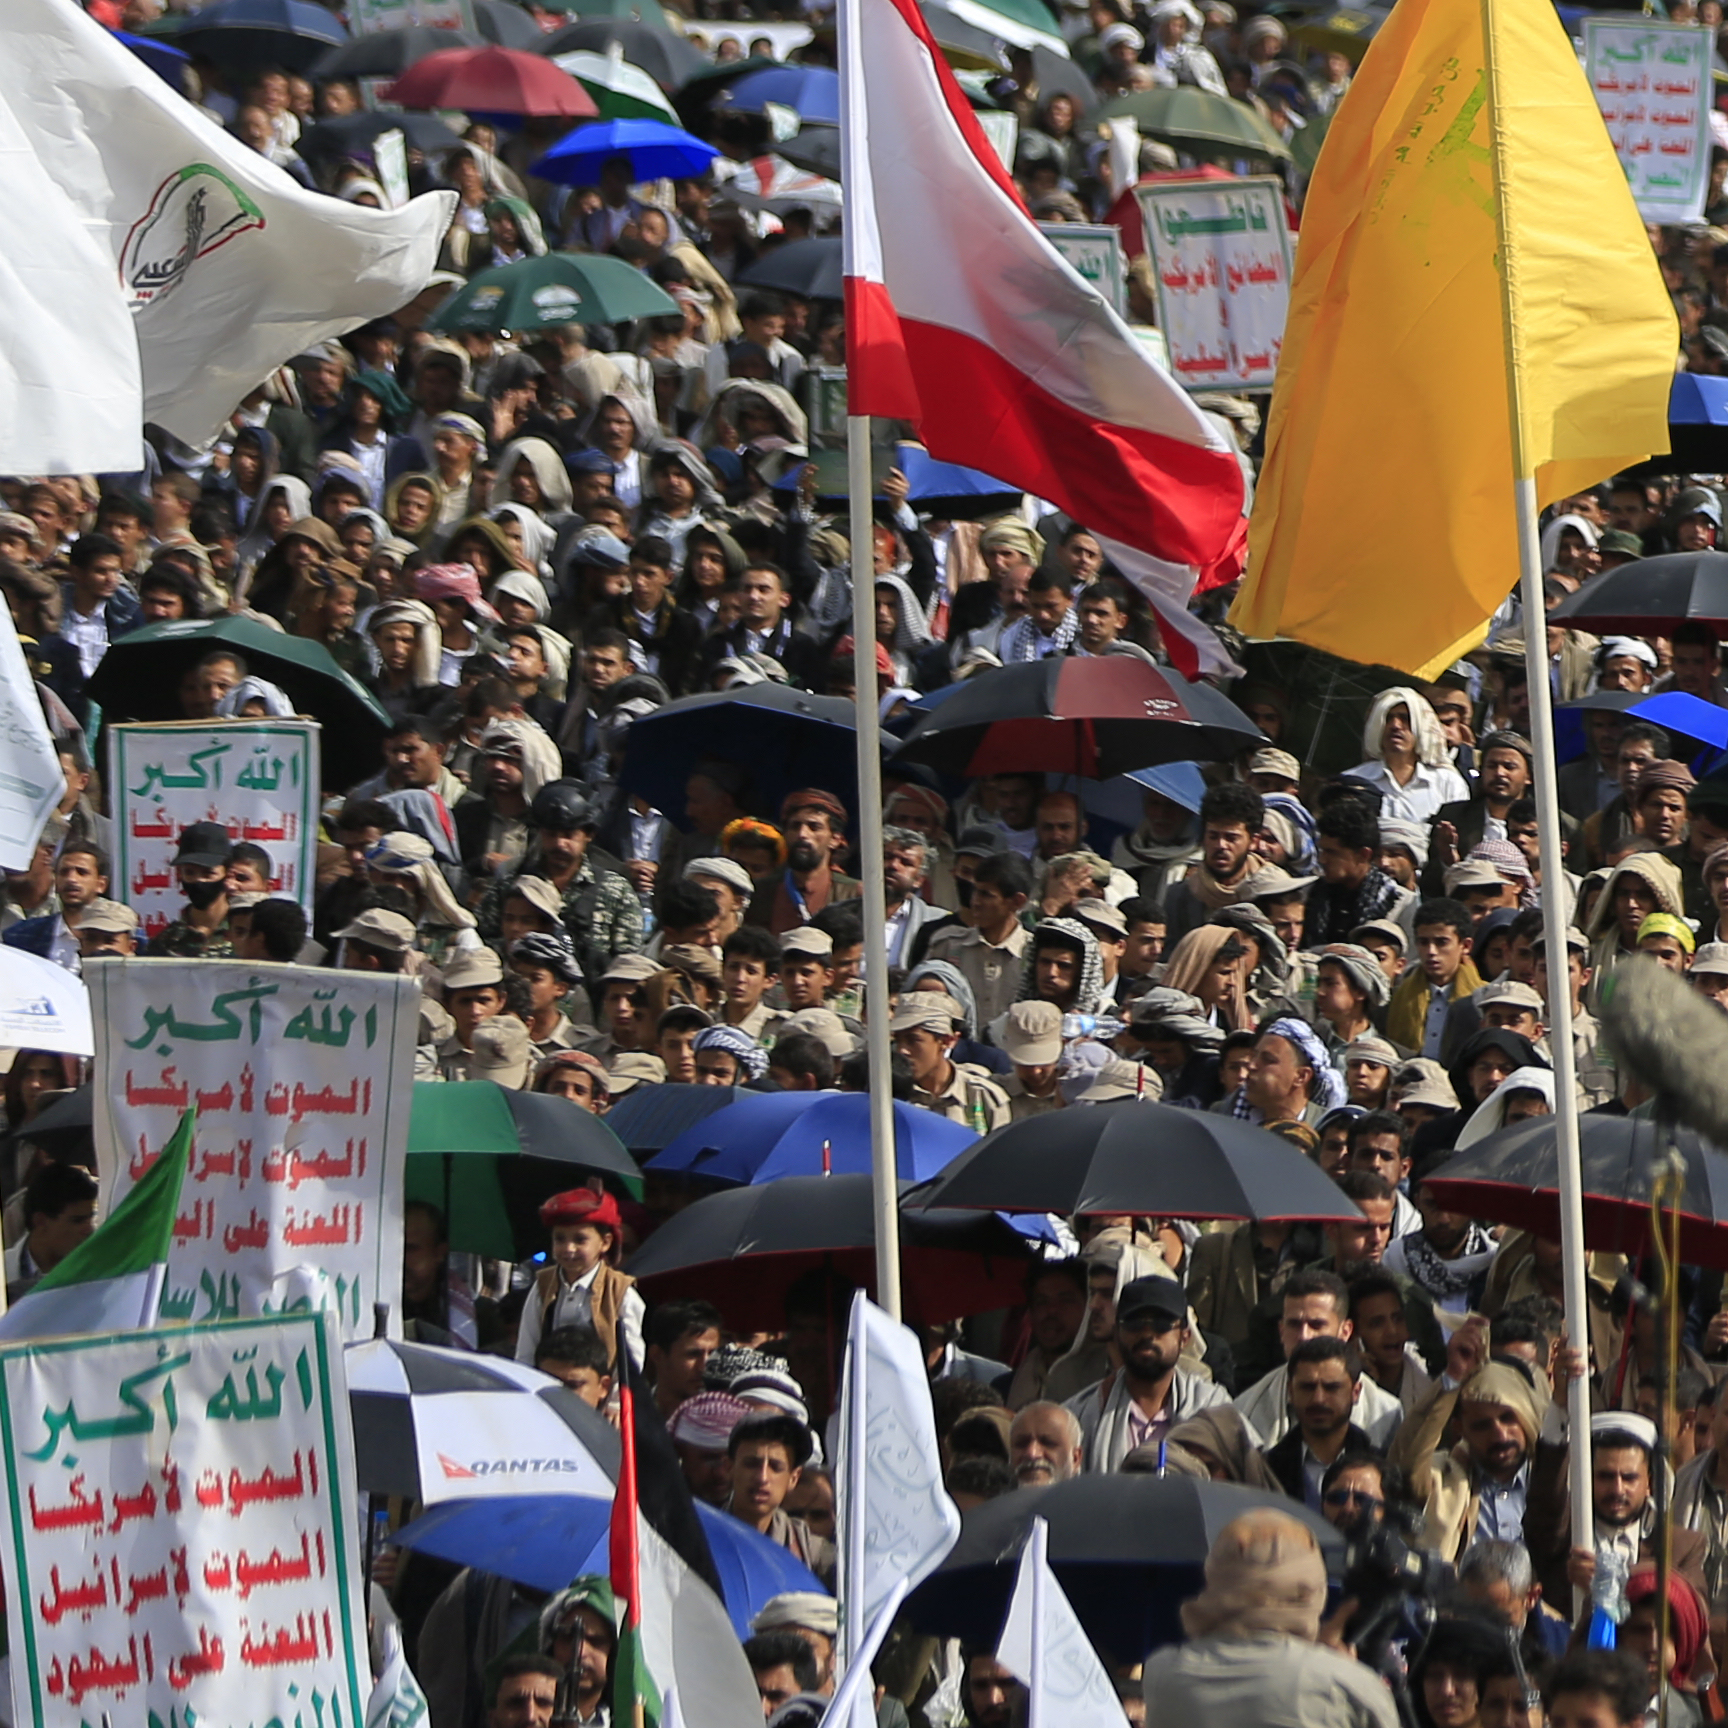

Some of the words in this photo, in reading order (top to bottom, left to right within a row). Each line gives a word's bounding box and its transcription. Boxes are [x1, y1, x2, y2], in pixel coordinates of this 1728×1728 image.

[128, 737, 233, 802] أكبر
[236, 746, 299, 790] الله
[124, 976, 279, 1057] أكبر
[283, 989, 377, 1049] الله
[264, 1077, 371, 1122] الموت
[262, 1137, 367, 1190] الموت
[224, 1207, 269, 1253] على
[283, 1203, 363, 1247] اللعنة
[22, 1346, 191, 1469] أكبر
[206, 1345, 315, 1422] الله
[196, 1445, 318, 1517] الموت
[471, 1459, 578, 1475] QANTAS
[204, 1527, 325, 1599] الموت
[169, 1624, 224, 1690] على
[240, 1607, 333, 1667] اللعنة
[47, 1631, 153, 1706] اليهود
